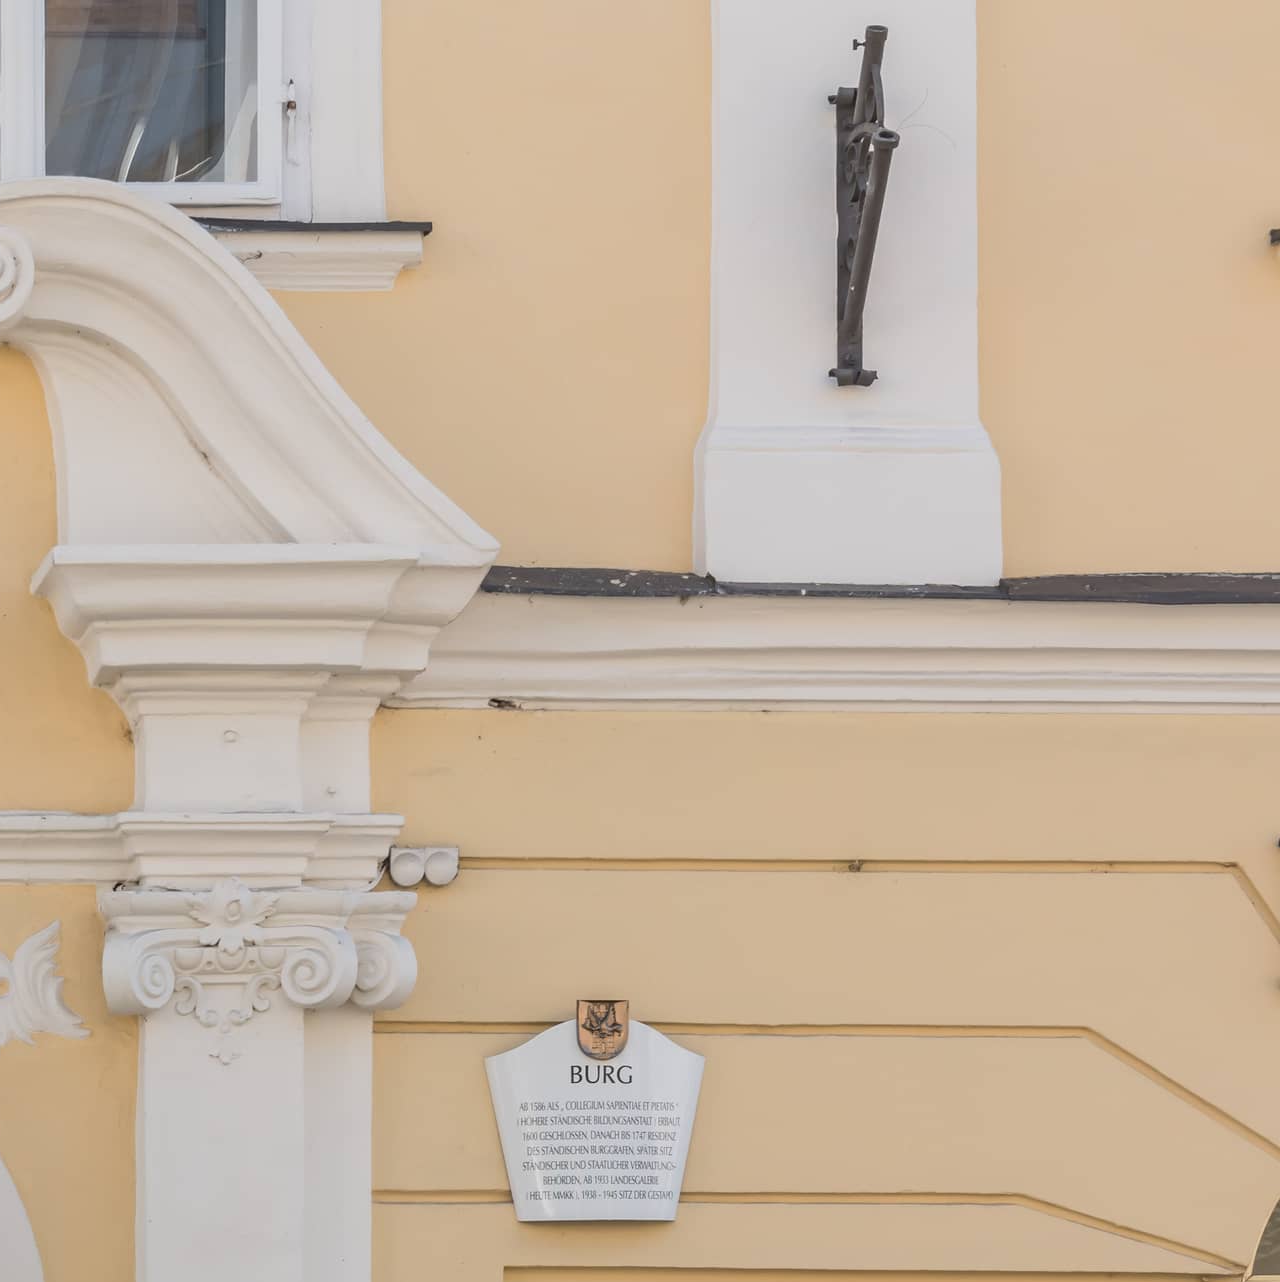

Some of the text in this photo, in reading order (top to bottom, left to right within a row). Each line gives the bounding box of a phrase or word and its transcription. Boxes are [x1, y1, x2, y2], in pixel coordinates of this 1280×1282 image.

[571, 1065, 632, 1084] BURG
[520, 1102, 529, 1112] AB
[547, 1101, 560, 1111] ALS
[565, 1100, 605, 1111] COLLEGIUM
[590, 1130, 620, 1140] DANACH
[620, 1130, 631, 1140] BIS
[527, 1146, 540, 1156] DES
[660, 1146, 673, 1156] SITZ
[570, 1160, 586, 1170] UND
[587, 1160, 629, 1170] STAATLICHER
[583, 1175, 592, 1185] AB
[610, 1175, 659, 1185] LANDESGALERIE
[529, 1191, 552, 1201] HEUTE
[619, 1190, 633, 1200] SITZ
[633, 1190, 648, 1200] DER
